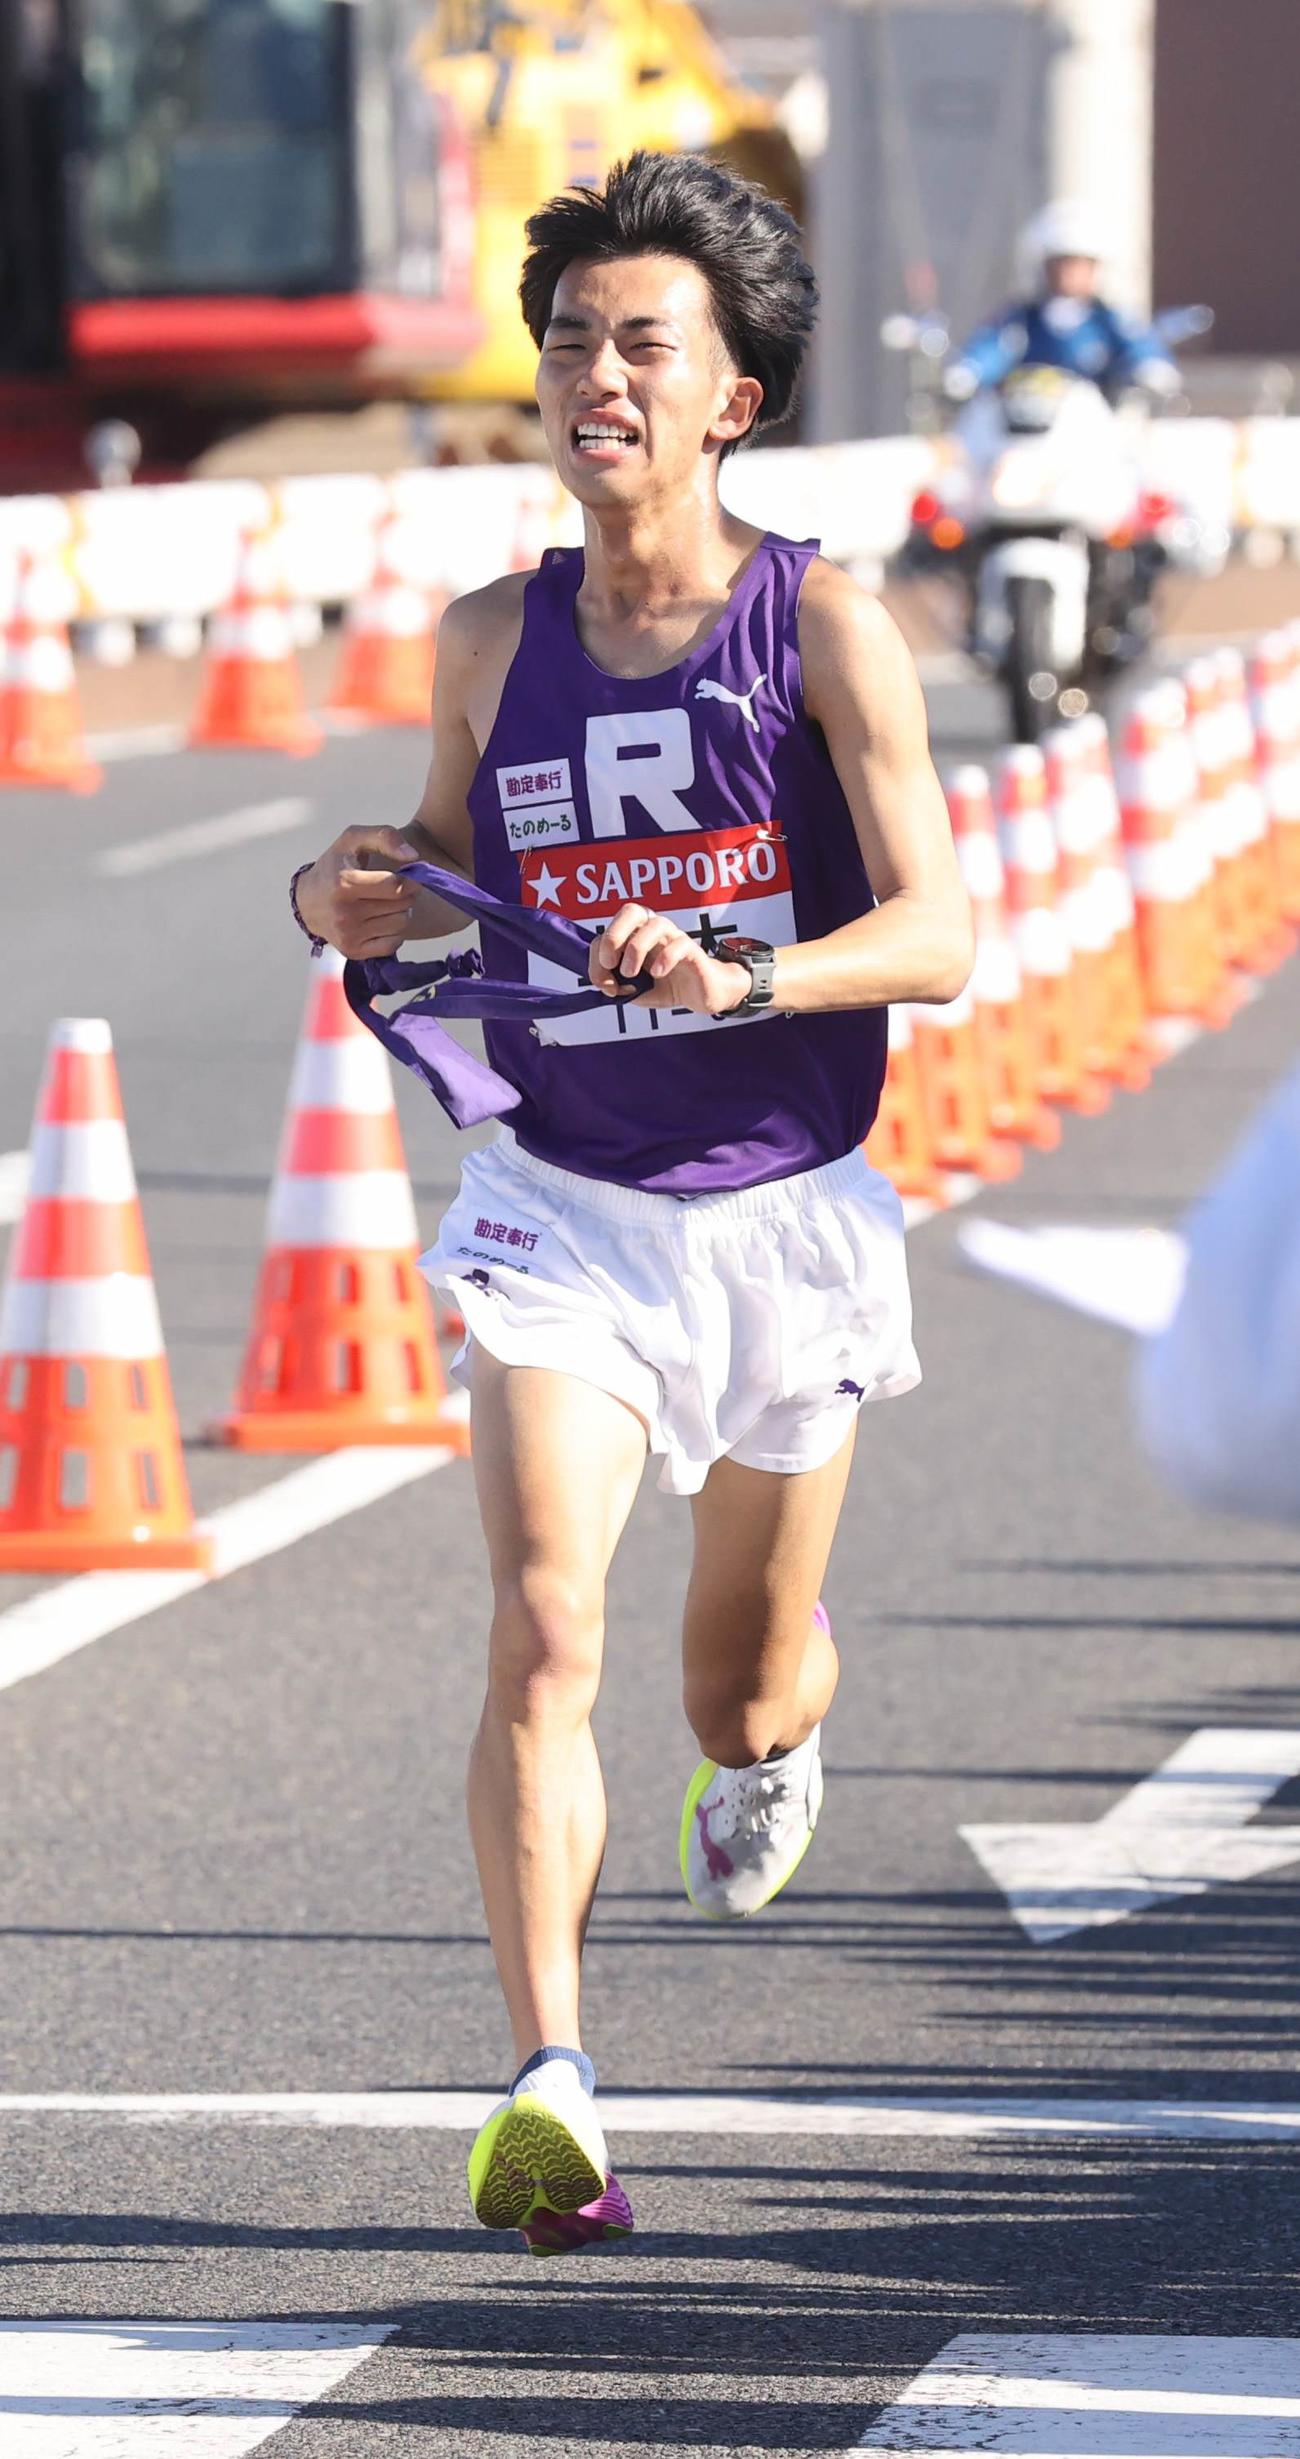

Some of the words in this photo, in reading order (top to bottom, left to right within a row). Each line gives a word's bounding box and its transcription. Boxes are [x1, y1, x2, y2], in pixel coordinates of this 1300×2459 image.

[506, 771, 562, 797] 勘定奉行
[585, 707, 703, 839] R
[510, 815, 571, 838] たのめーる
[576, 842, 777, 904] SAPPORO
[474, 1218, 539, 1251] 勘定奉行
